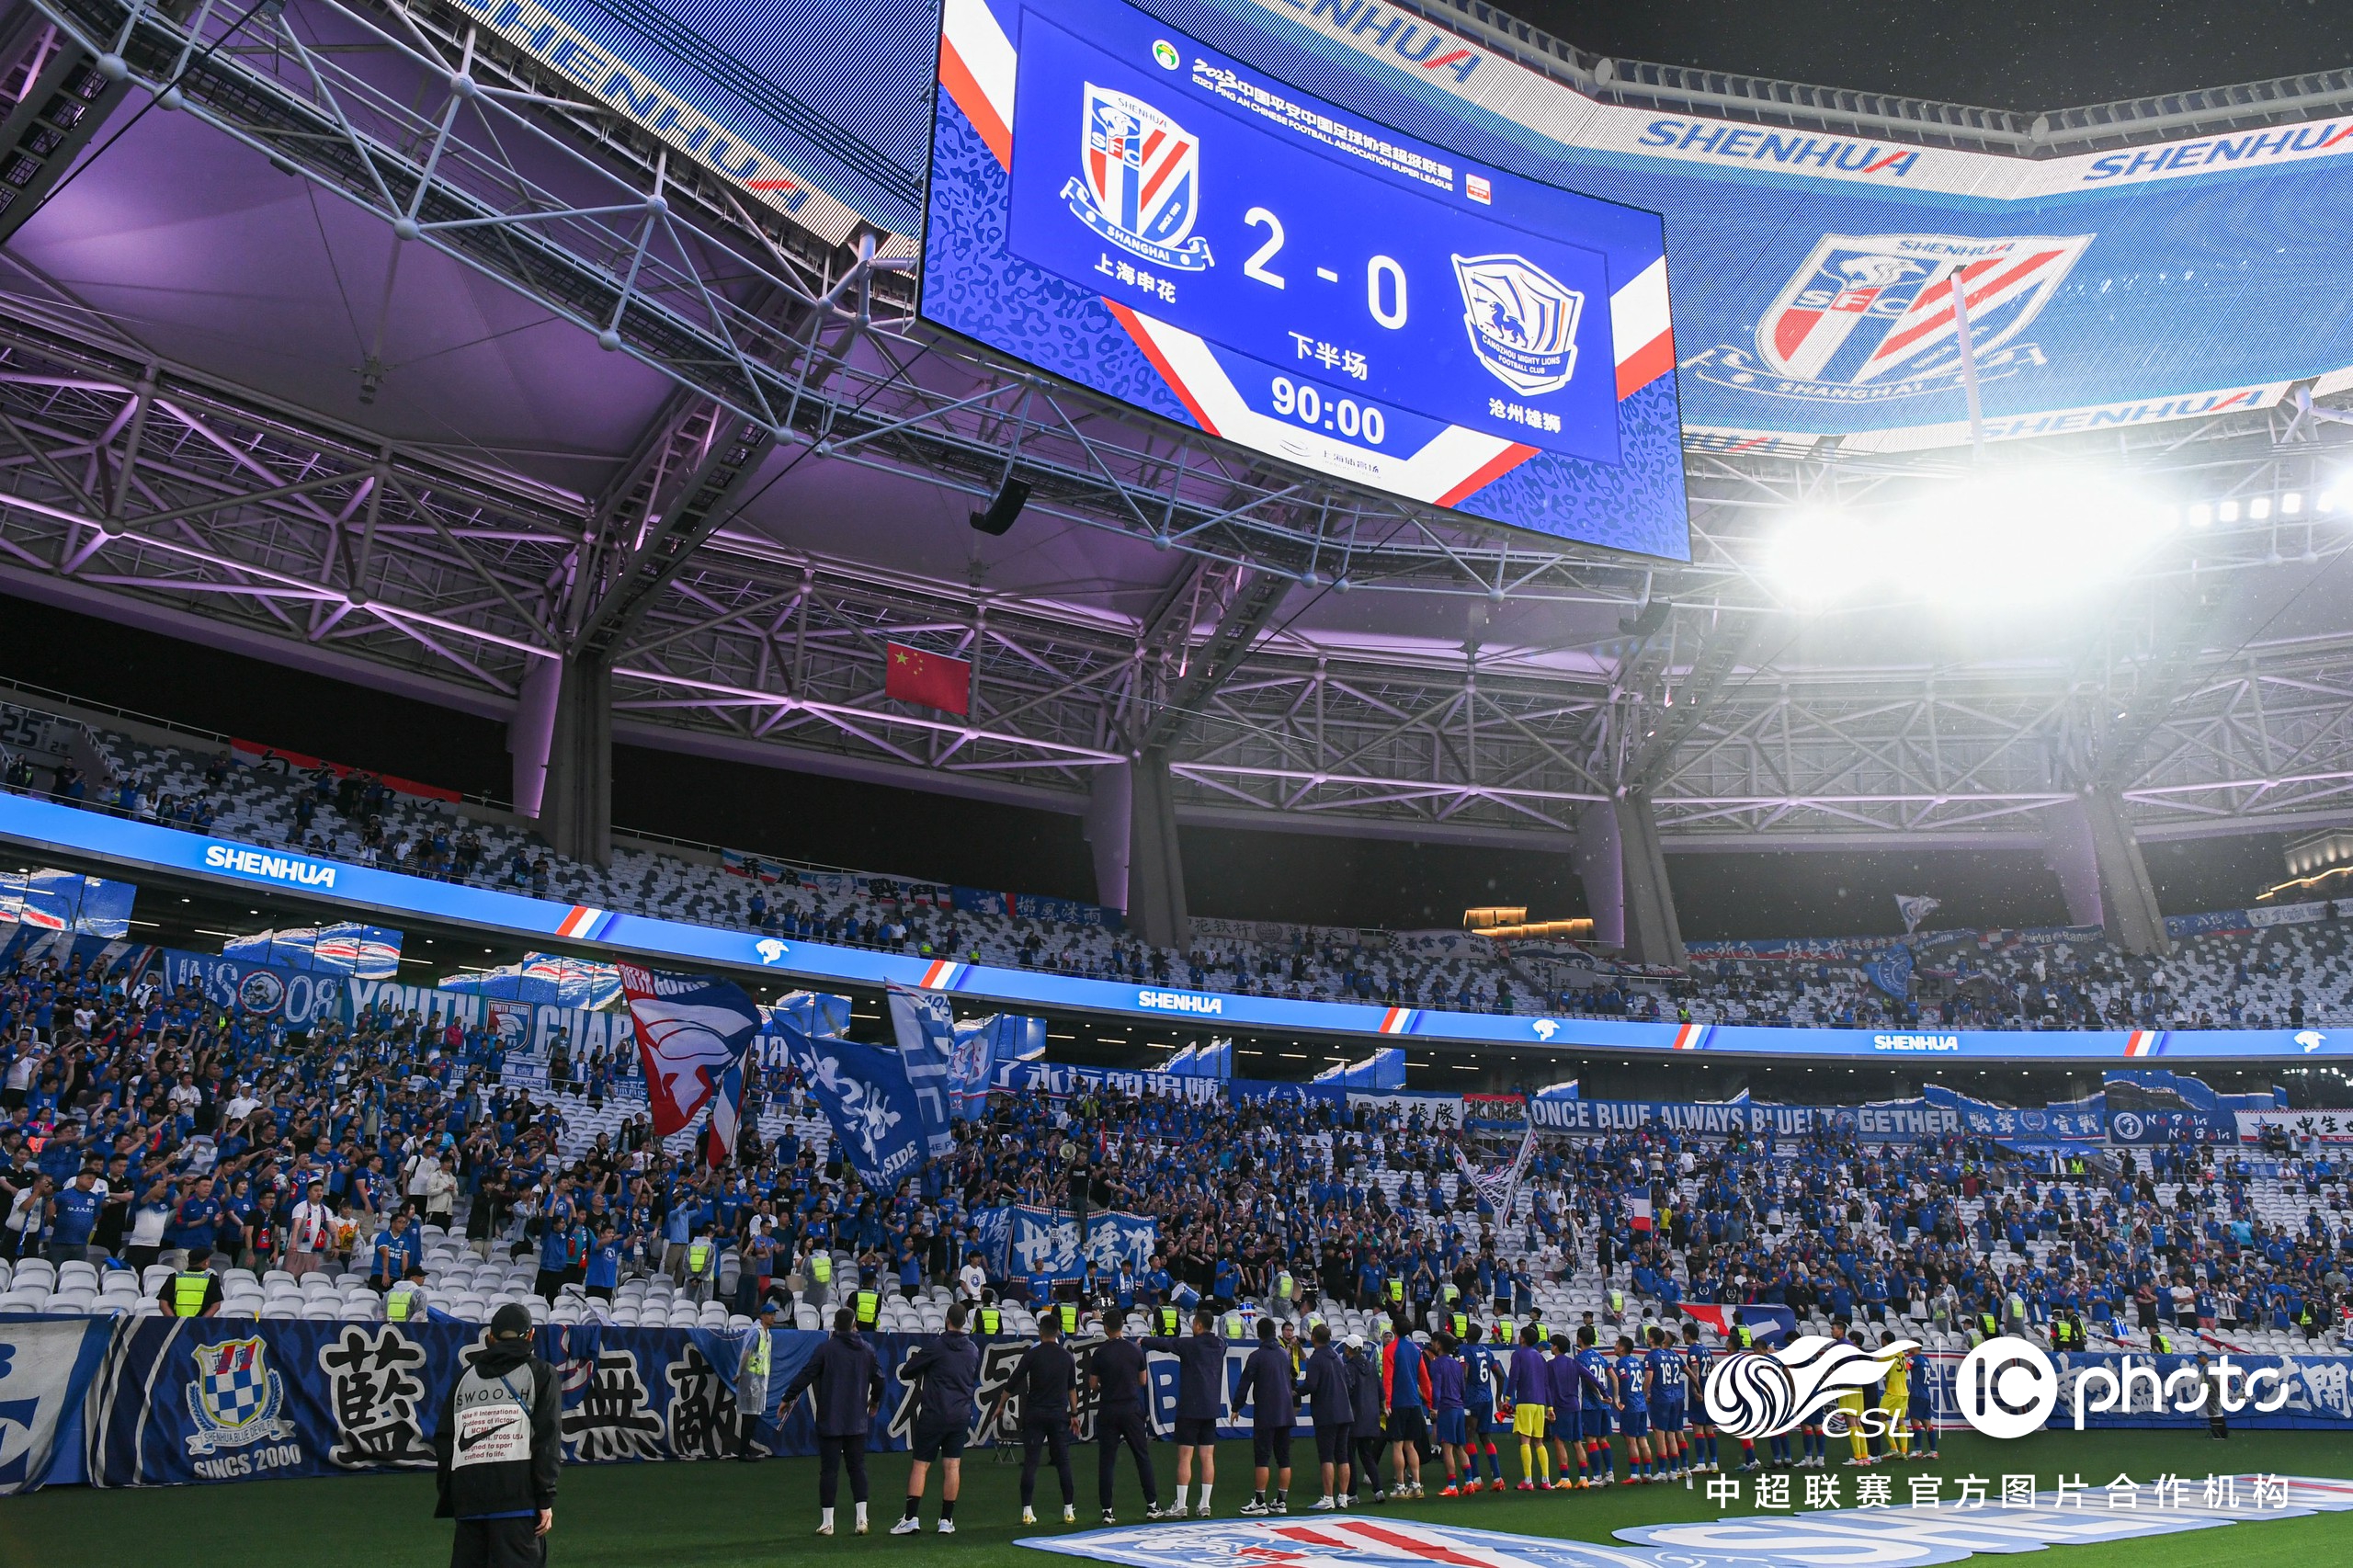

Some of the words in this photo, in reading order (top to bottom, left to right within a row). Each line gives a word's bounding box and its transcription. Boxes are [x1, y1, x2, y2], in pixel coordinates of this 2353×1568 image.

[1119, 97, 1167, 128] SHENHUA
[1192, 74, 1214, 91] 2023
[1215, 83, 1237, 101] PING
[1237, 97, 1251, 108] AN
[1251, 102, 1289, 125] CHINESE
[1288, 119, 1334, 146] FOOTBALL
[1335, 139, 1391, 168] ASSOCIATION
[1392, 160, 1420, 179] SUPER
[1420, 172, 1453, 191] LEAGUE
[1637, 119, 1920, 177] SHENHUA
[1107, 225, 1170, 262] SHANGHAI
[1094, 253, 1176, 303] 上海申花
[1243, 206, 1286, 290] 2
[1368, 256, 1408, 330] 0
[1288, 330, 1368, 381] 下半场
[1482, 335, 1517, 359] CANGZHOU
[1518, 354, 1540, 365] MIGHTY
[1541, 356, 1561, 366] LIONS
[1498, 355, 1529, 372] FOOTBALL
[1529, 365, 1545, 374] CLUB
[1271, 376, 1385, 445] 90:00
[1488, 397, 1562, 433] 沧州雄狮
[205, 846, 336, 889] SHENHUA
[284, 974, 337, 1023] 08
[348, 977, 480, 1048] YOUTH
[490, 1002, 508, 1012] YOUTH
[508, 1005, 529, 1016] GUARD
[1138, 991, 1222, 1014] SHENHUA
[1874, 1034, 1958, 1051] SHENHUA
[1531, 1099, 1590, 1128] ONCE
[1661, 1106, 1745, 1133] ALWAYS
[1750, 1108, 1813, 1136] BLUE!
[884, 1140, 918, 1177] SIDE
[1480, 1359, 1488, 1382] 6
[1660, 1362, 1672, 1384] 19
[1895, 1356, 1907, 1372] 30
[1631, 1369, 1643, 1392] 29
[462, 1419, 485, 1427] Goddess
[479, 1408, 518, 1416] International
[249, 1423, 267, 1439] DEVIL
[267, 1420, 275, 1430] FC
[253, 1443, 302, 1471] 2000
[464, 1452, 484, 1460] crafted
[495, 1442, 513, 1450] sport
